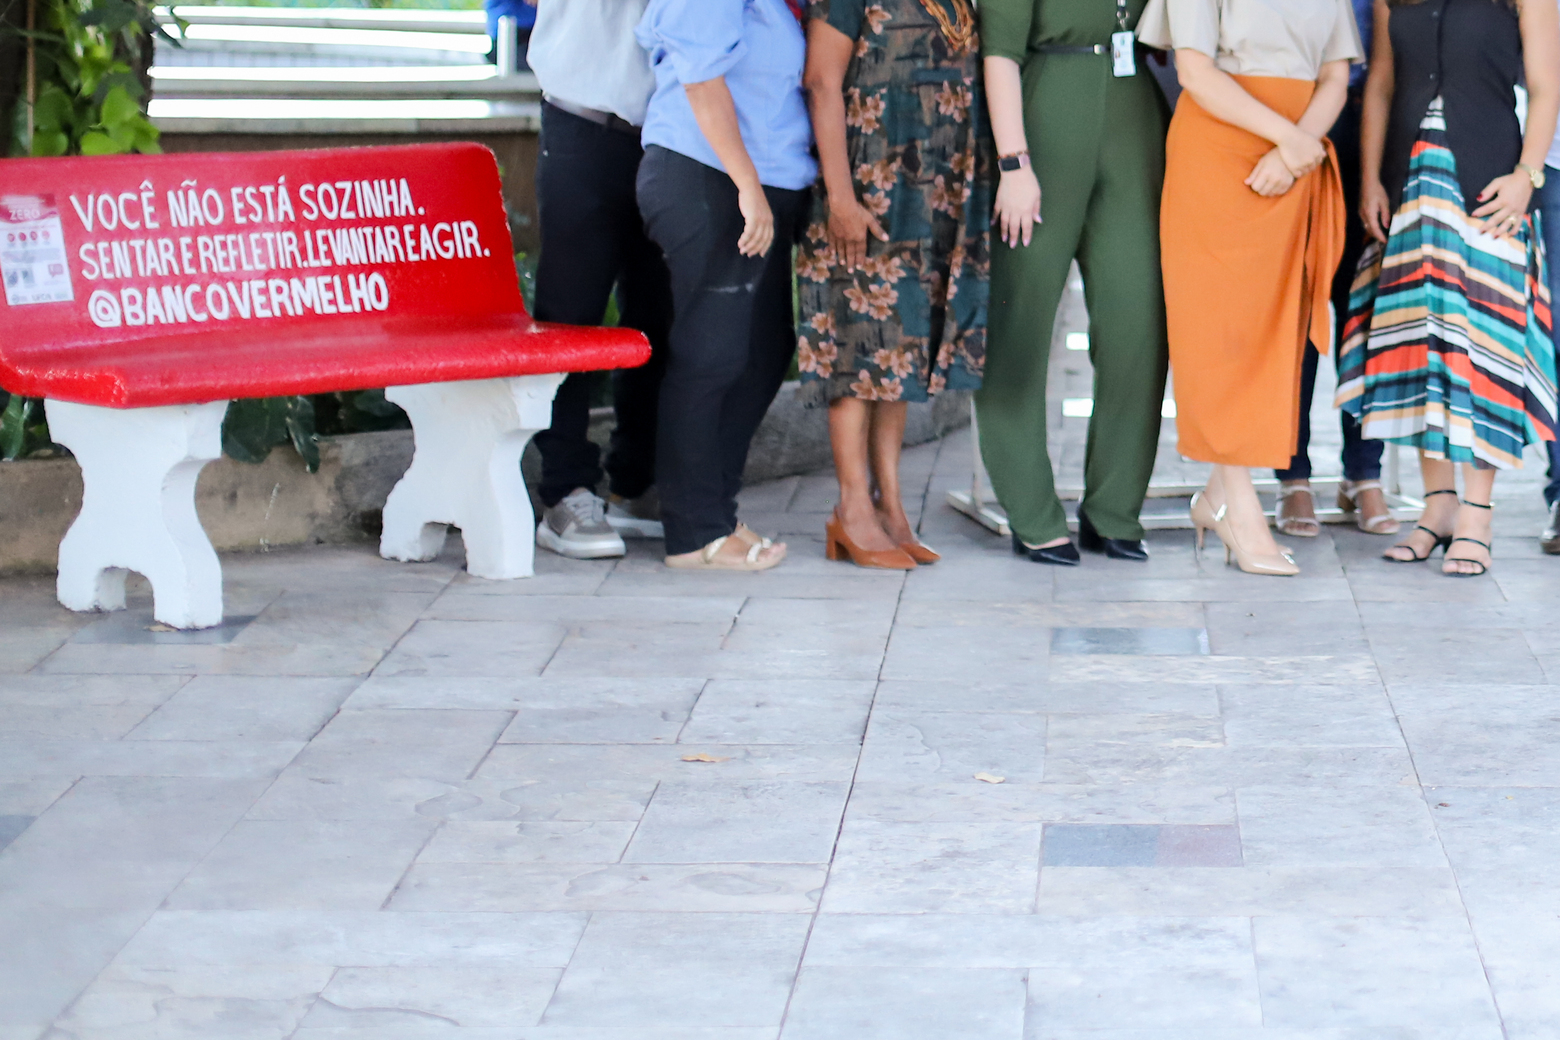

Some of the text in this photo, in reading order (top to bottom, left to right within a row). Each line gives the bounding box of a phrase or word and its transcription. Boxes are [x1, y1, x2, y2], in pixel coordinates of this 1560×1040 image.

[9, 209, 41, 220] ZERO
[69, 175, 426, 232] VOCÊ NÃO ESTÁ SOZINHA.
[79, 237, 180, 280] SENTAR
[179, 236, 198, 274] E
[420, 220, 491, 261] AGIR.
[87, 271, 390, 328] @BANCOVERMELHO
